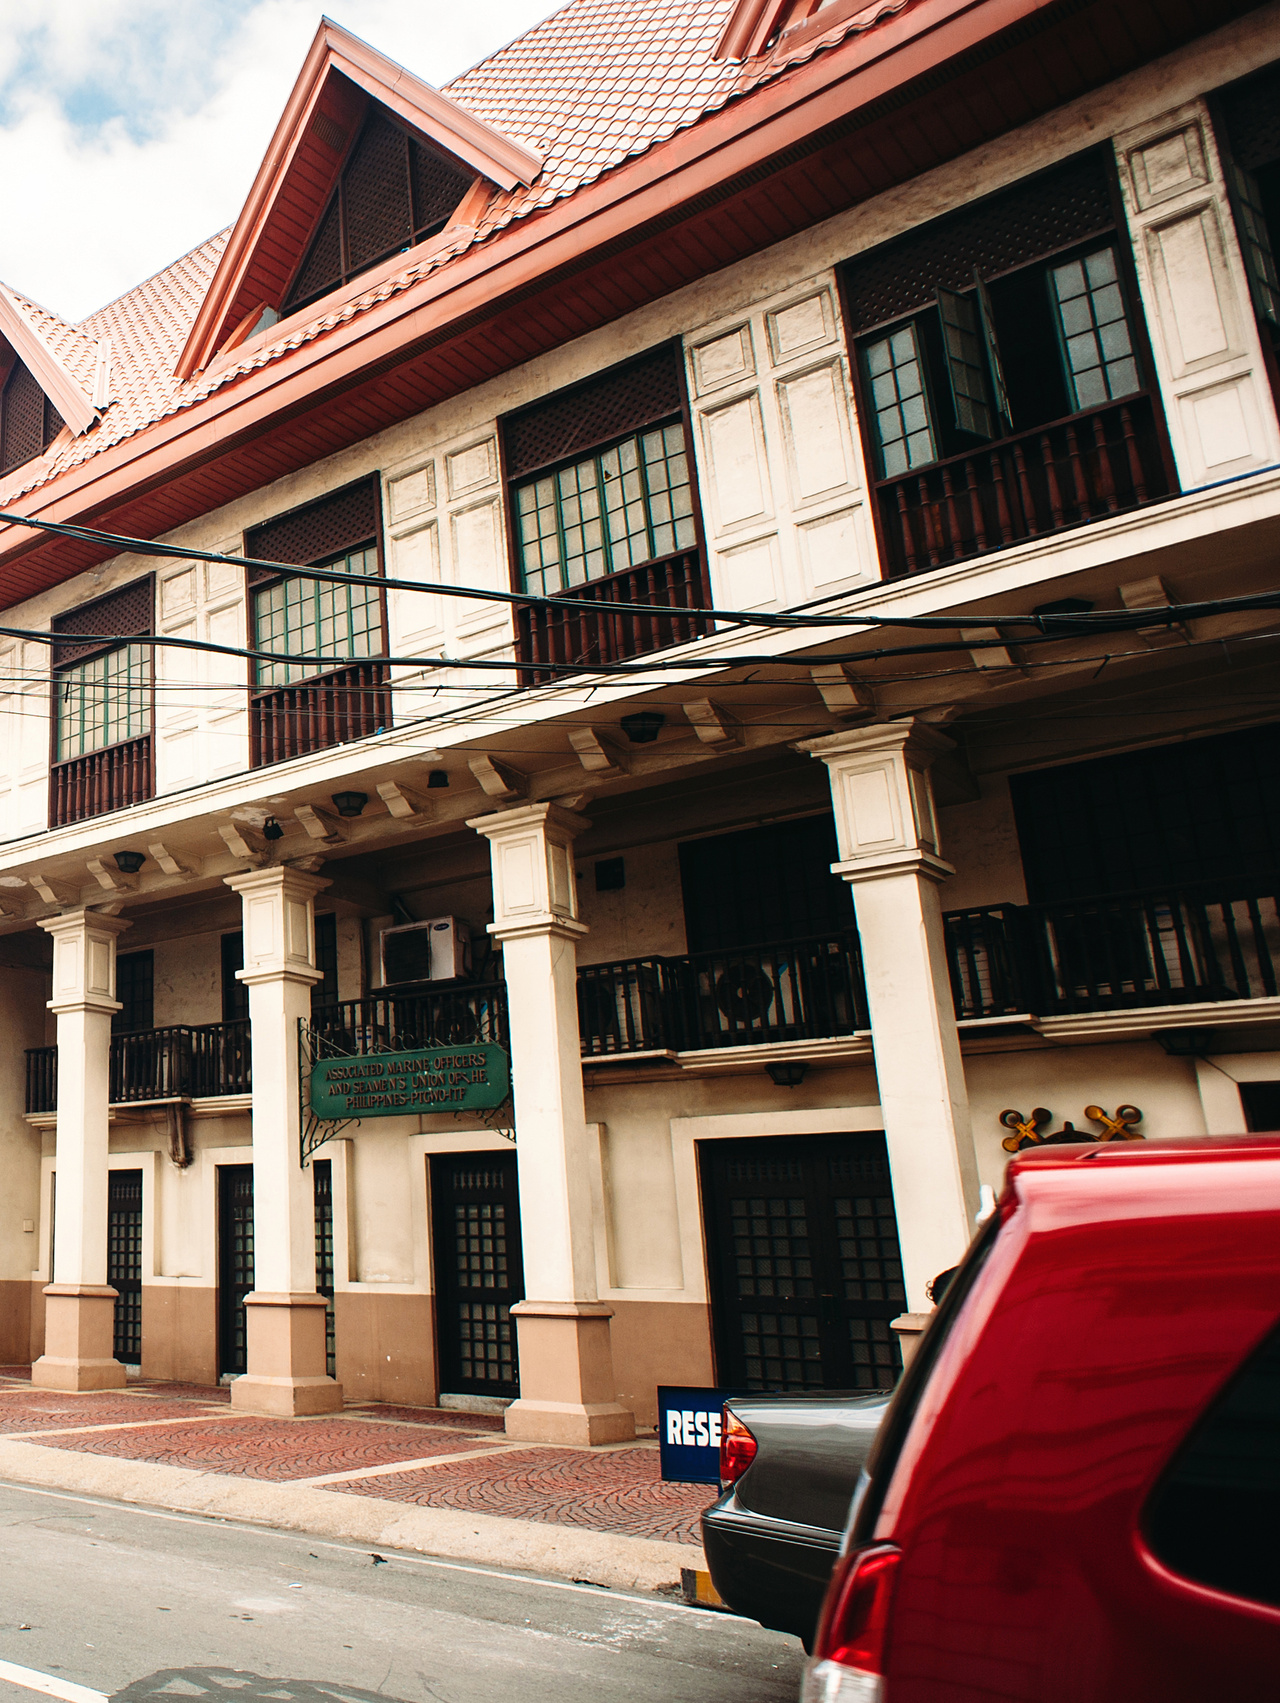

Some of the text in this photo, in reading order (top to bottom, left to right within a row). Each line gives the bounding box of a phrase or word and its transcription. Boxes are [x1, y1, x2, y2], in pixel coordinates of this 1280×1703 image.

[326, 1052, 487, 1081] ASSOCIATED MARINE OFFICERS
[328, 1082, 351, 1097] AND
[353, 1076, 407, 1095] SEAMEN'S
[411, 1072, 446, 1089] UNION
[448, 1071, 462, 1086] OF
